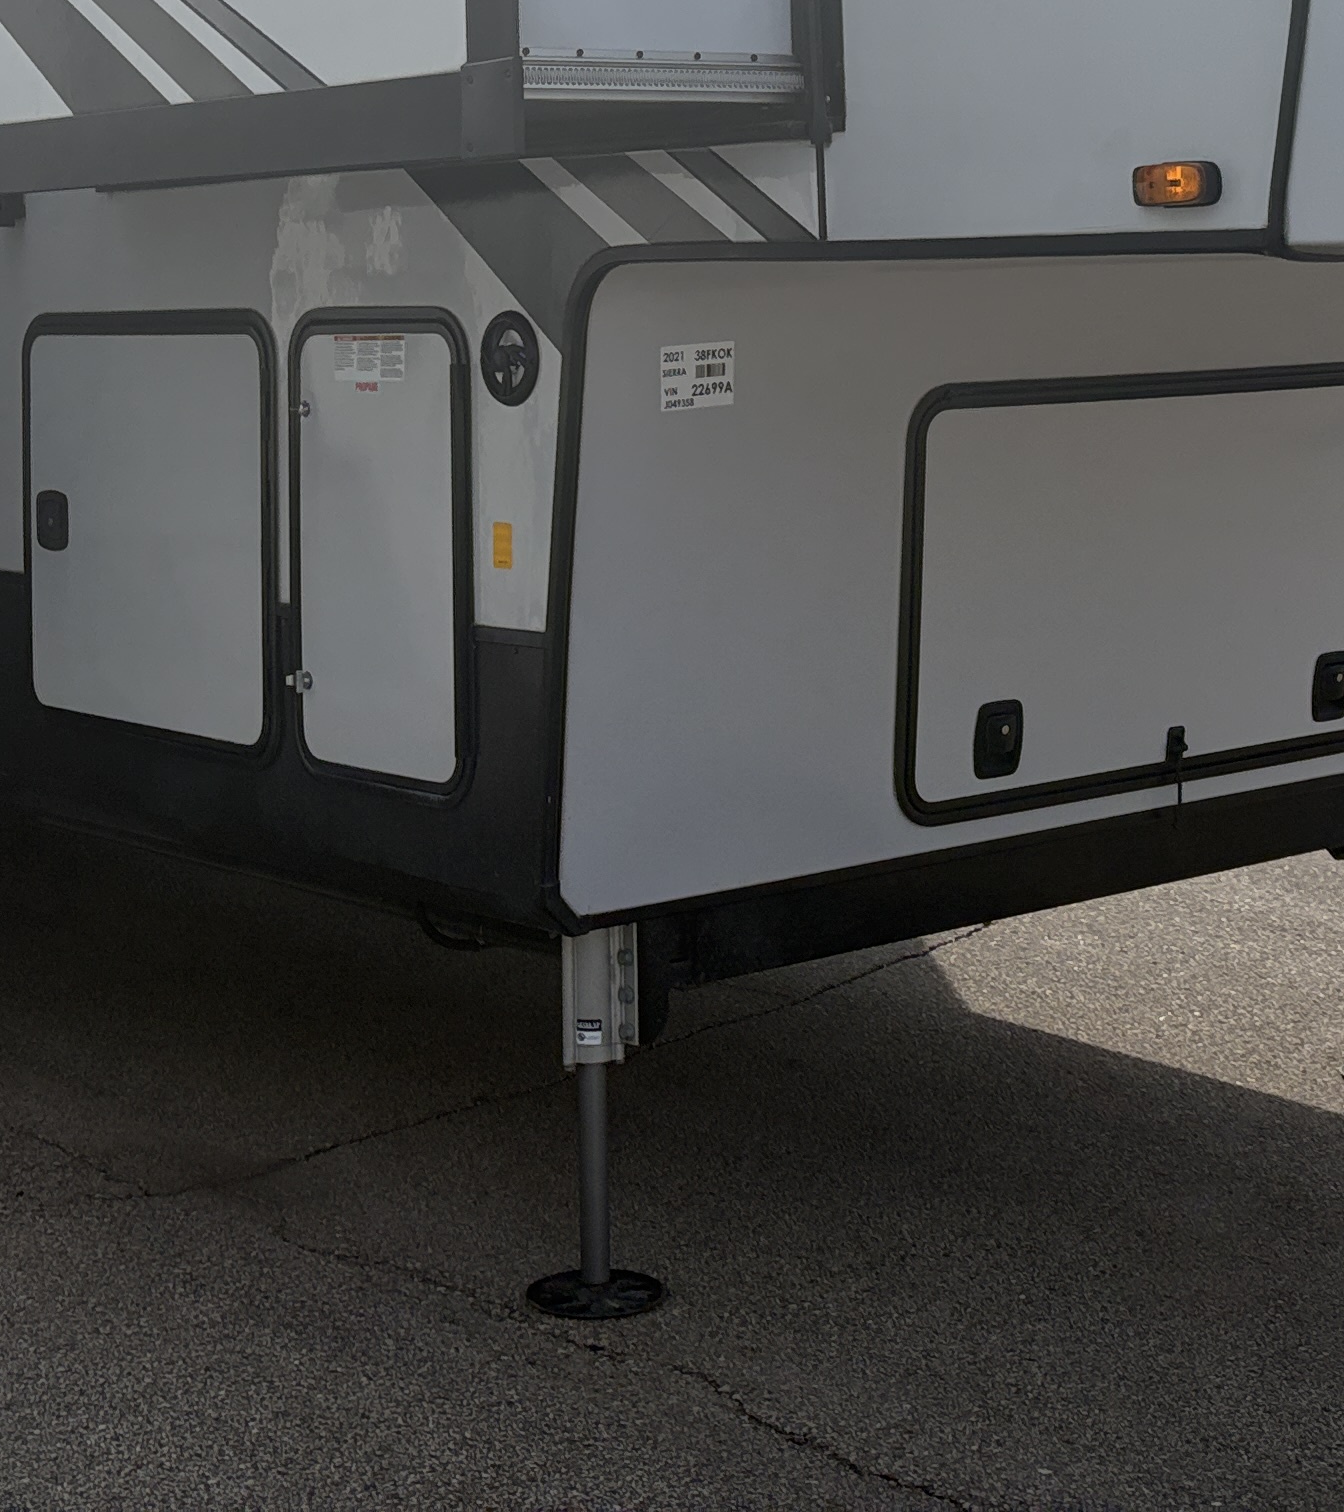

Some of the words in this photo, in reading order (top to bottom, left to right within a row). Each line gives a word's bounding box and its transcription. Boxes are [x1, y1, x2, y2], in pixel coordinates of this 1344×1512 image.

[663, 351, 684, 363] 2021
[664, 387, 678, 397] VIN
[691, 381, 733, 397] 22699A
